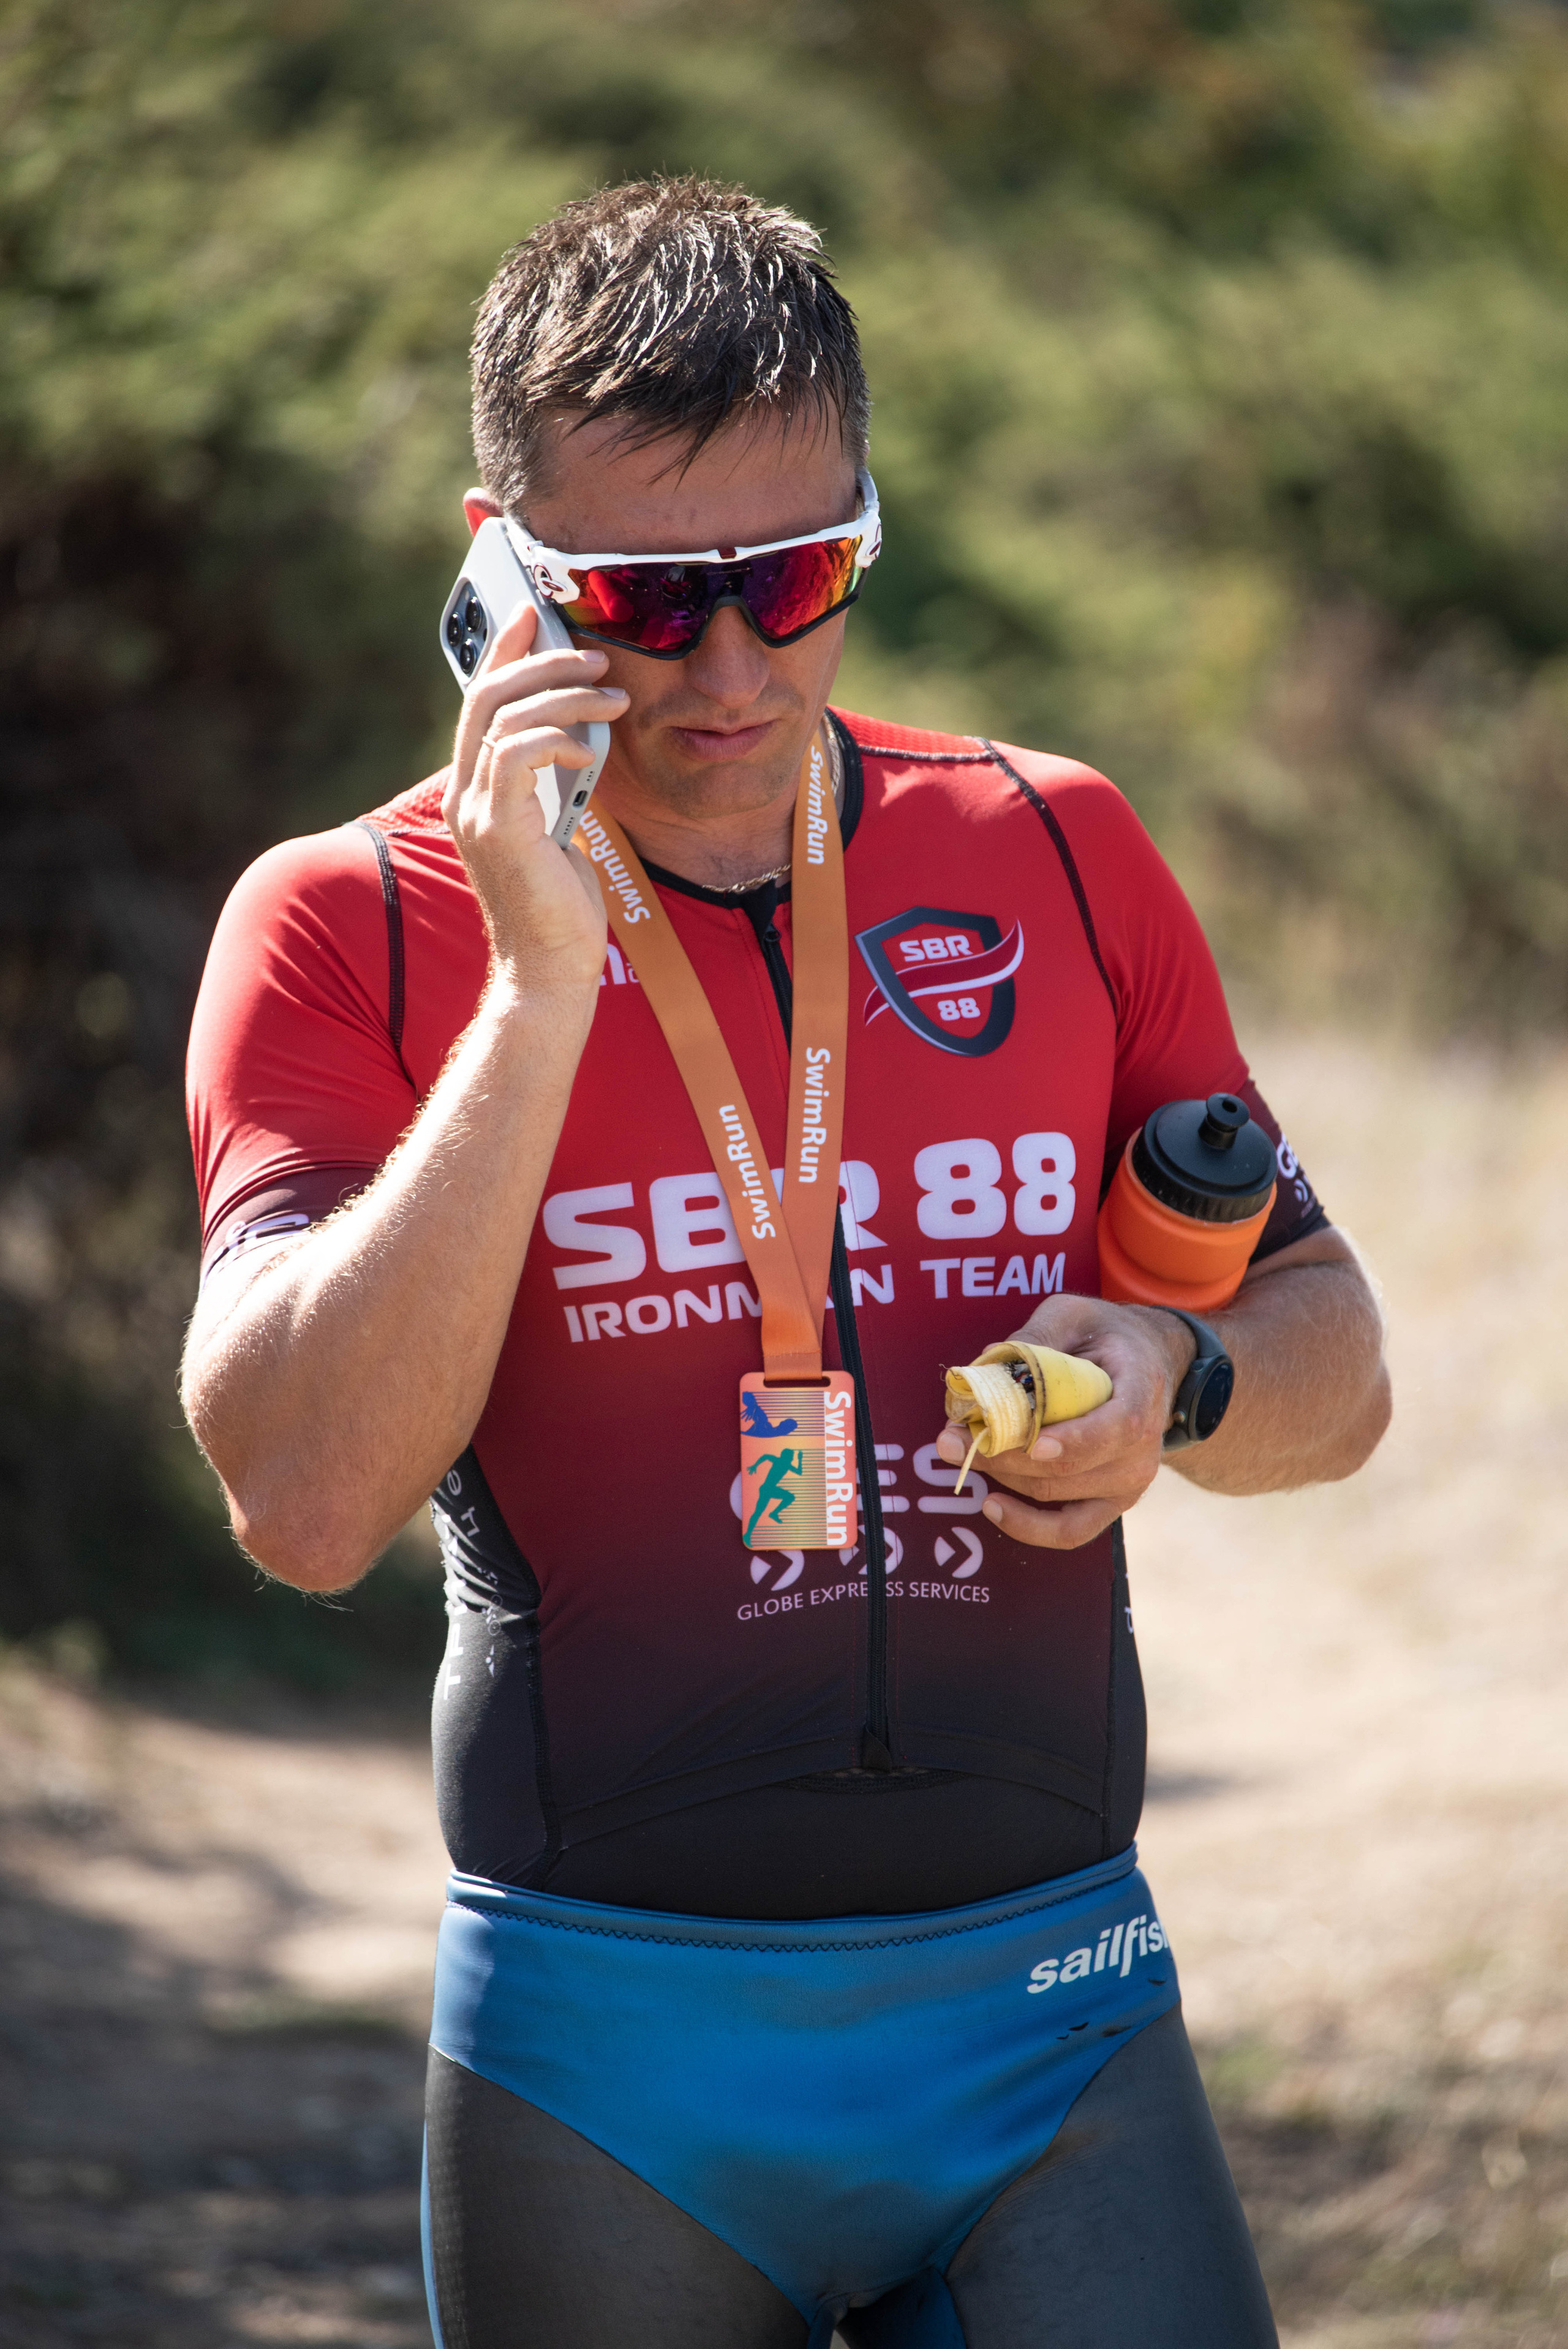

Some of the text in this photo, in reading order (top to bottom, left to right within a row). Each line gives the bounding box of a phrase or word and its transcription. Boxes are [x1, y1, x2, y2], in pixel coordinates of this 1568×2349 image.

[807, 745, 829, 864] SwimRun
[579, 810, 651, 923] SwimRun
[900, 935, 973, 962] SBR
[938, 997, 981, 1021] 88
[799, 1047, 831, 1184] SwimRun
[718, 1105, 776, 1239] SwimRun
[914, 1131, 1077, 1239] 88
[564, 1252, 1066, 1342] IRONMN TEAM
[824, 1391, 854, 1546] SwimRun
[737, 1581, 990, 1621] GLOBE EXPRESS SERVICES
